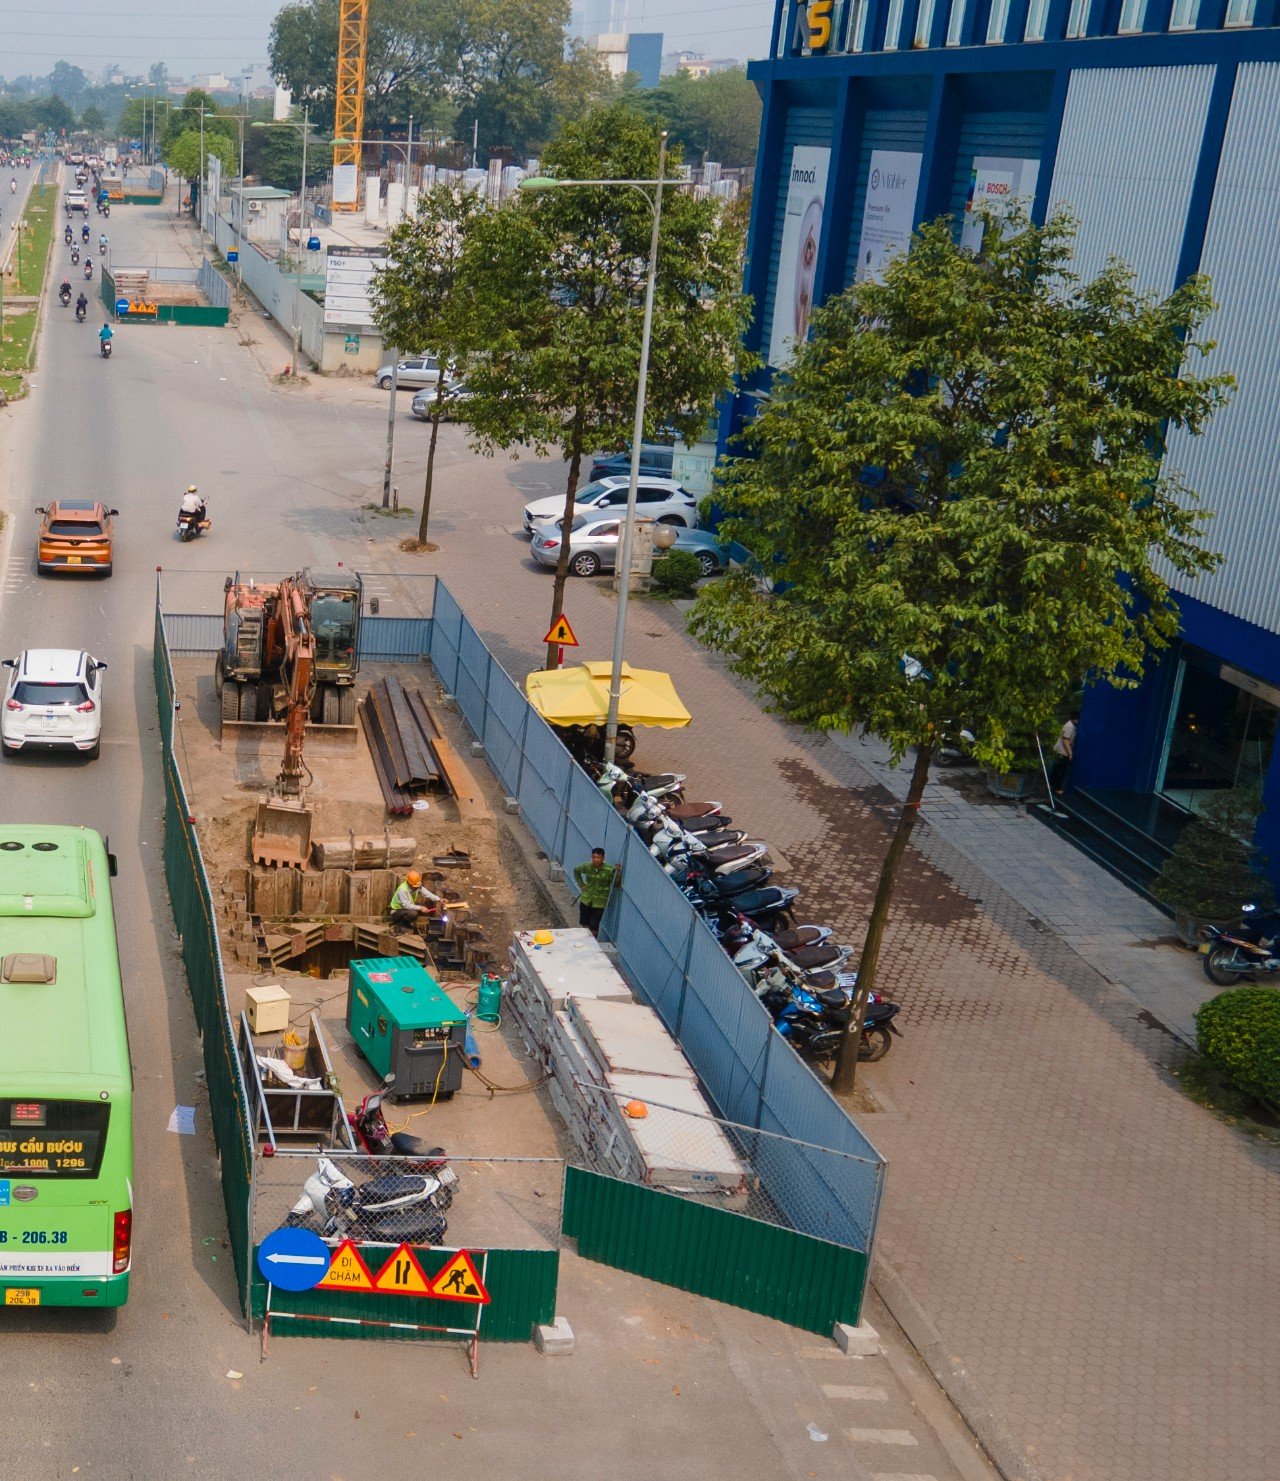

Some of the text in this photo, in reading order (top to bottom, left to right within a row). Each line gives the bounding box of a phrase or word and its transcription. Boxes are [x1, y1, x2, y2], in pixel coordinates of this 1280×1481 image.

[986, 182, 1008, 195] BOSCH
[56, 1158, 85, 1167] 1296
[22, 1231, 68, 1244] 206.38
[341, 1257, 352, 1267] ĐI
